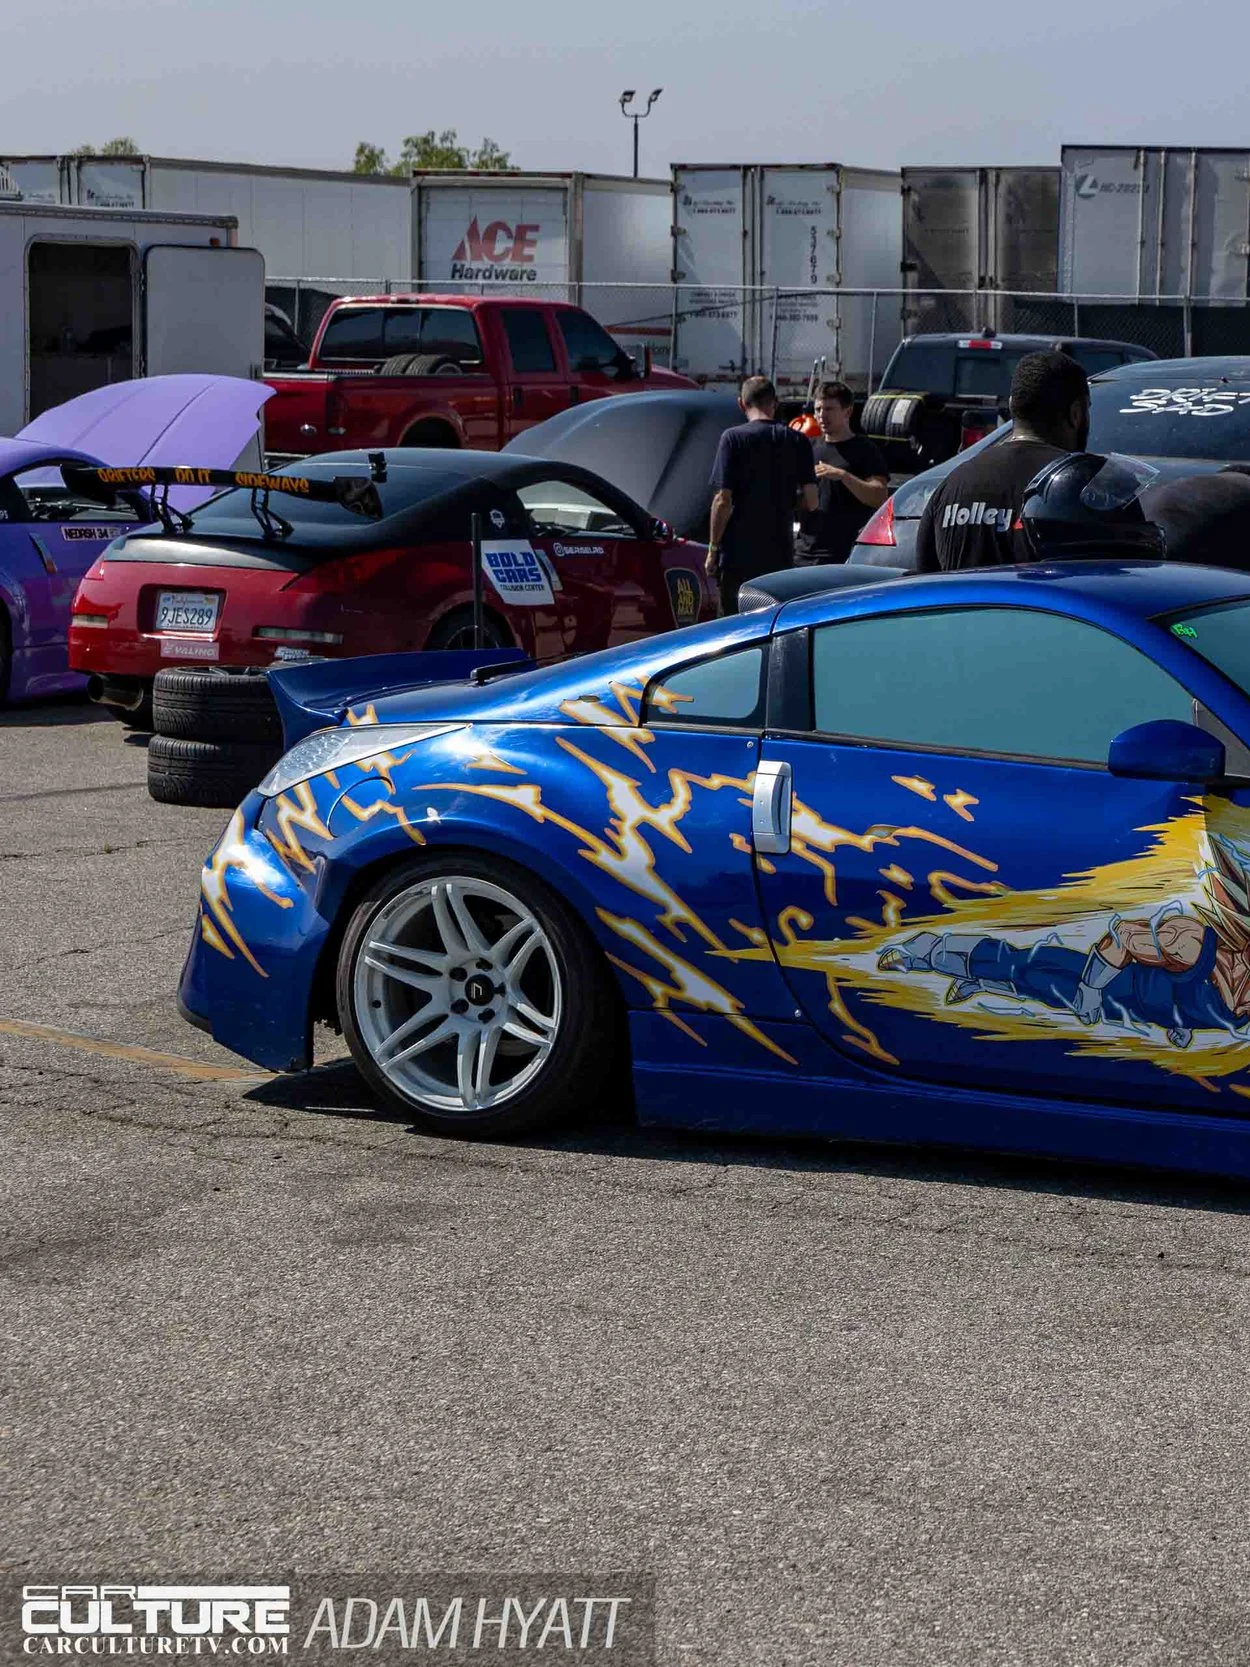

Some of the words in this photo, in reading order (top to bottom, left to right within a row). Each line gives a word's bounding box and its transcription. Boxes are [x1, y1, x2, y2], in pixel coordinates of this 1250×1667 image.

[450, 214, 540, 262] ACE
[451, 263, 538, 281] Hardware
[97, 467, 156, 484] DRIFTERS
[175, 468, 195, 483] DO
[199, 468, 212, 484] IT
[235, 472, 310, 493] SIDEWAYS
[942, 501, 1013, 533] Holley
[485, 552, 536, 568] BOLD
[492, 567, 542, 583] CARS
[161, 606, 213, 626] 9JES289
